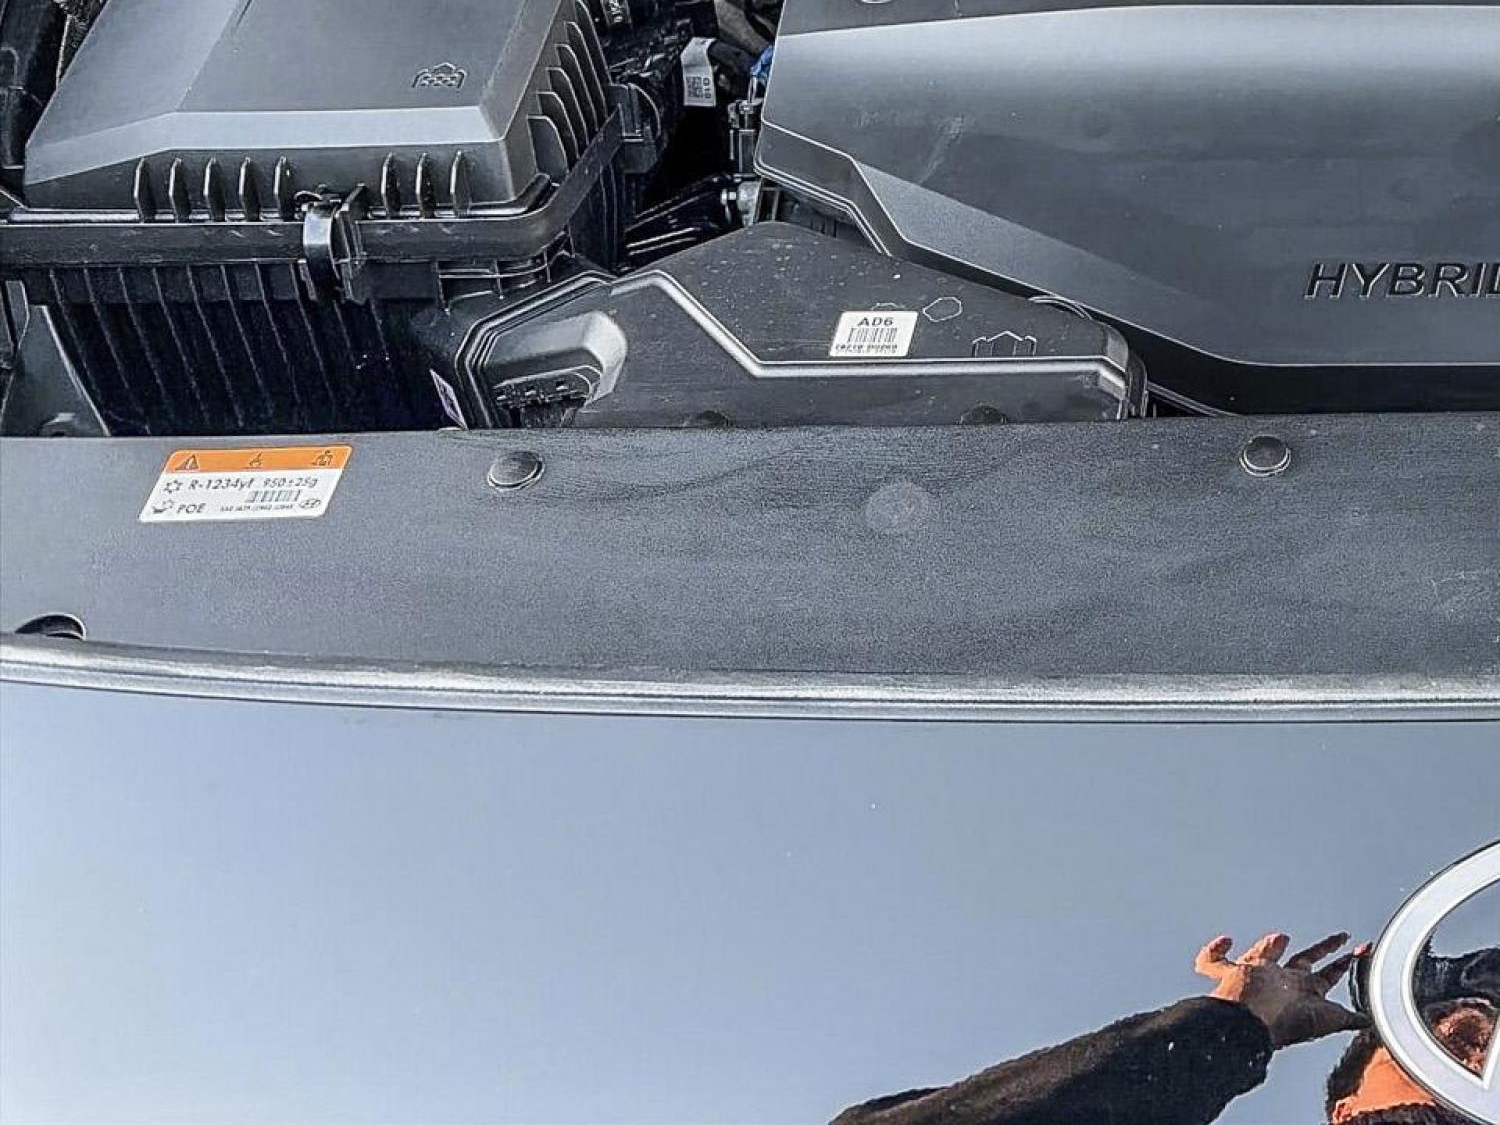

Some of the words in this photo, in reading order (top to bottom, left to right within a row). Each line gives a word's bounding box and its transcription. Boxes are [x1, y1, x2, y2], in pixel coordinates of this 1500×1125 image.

[857, 317, 895, 327] AD6
[188, 477, 255, 491] R-1234yf
[176, 502, 207, 515] POE
